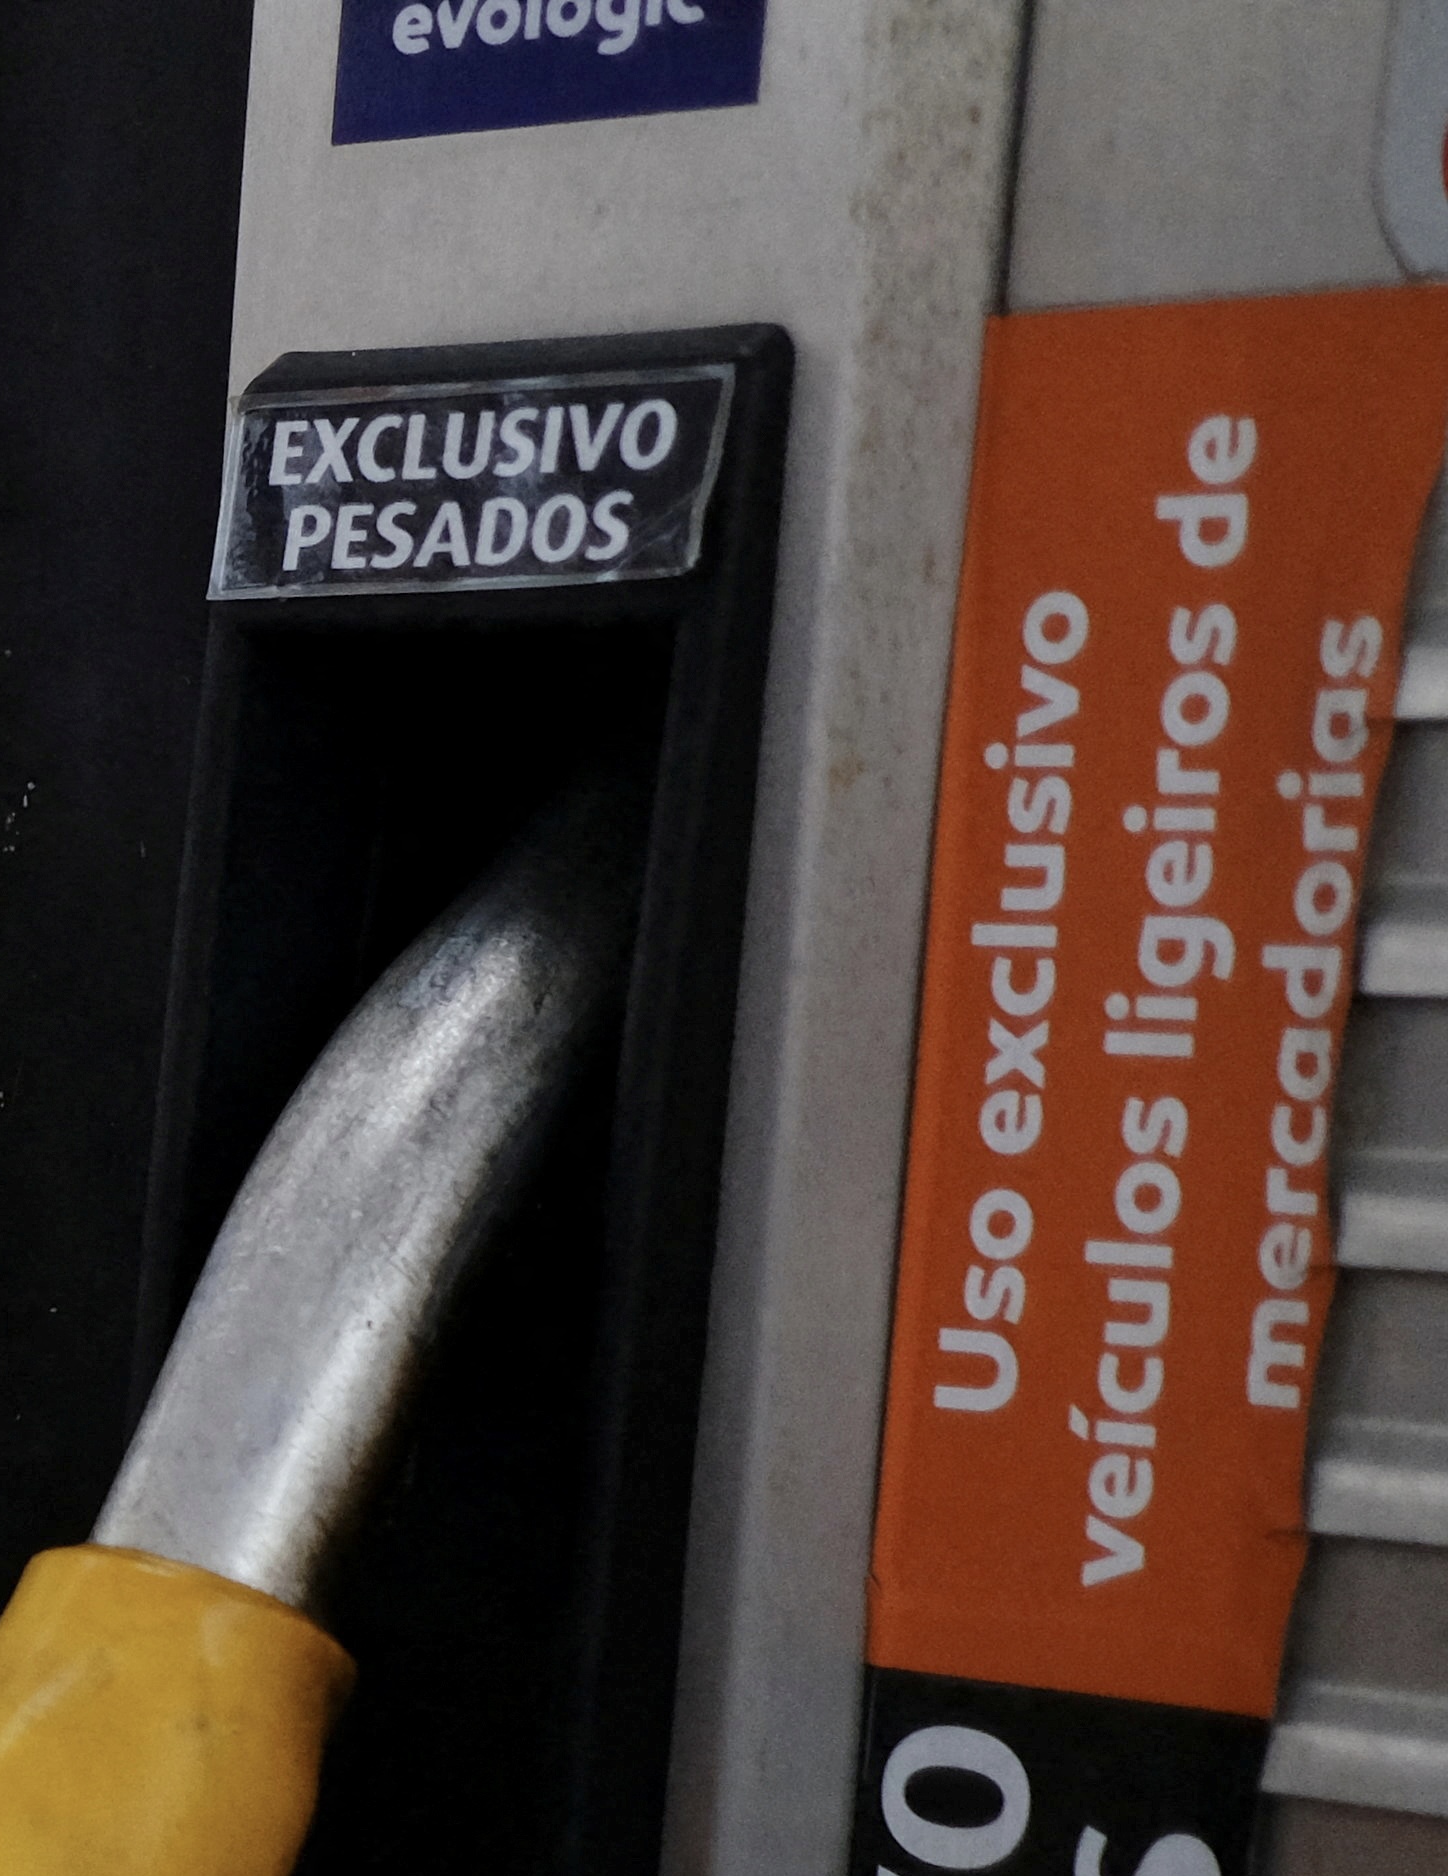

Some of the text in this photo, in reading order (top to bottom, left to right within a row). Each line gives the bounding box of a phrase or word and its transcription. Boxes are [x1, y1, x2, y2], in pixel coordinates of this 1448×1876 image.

[268, 398, 679, 486] EXCLUSIVO
[281, 489, 635, 572] PESADOS
[933, 590, 1090, 1412] Uso exclusivo
[1067, 413, 1259, 1588] veículos ligeiros de
[1245, 614, 1384, 1410] mercadorias
